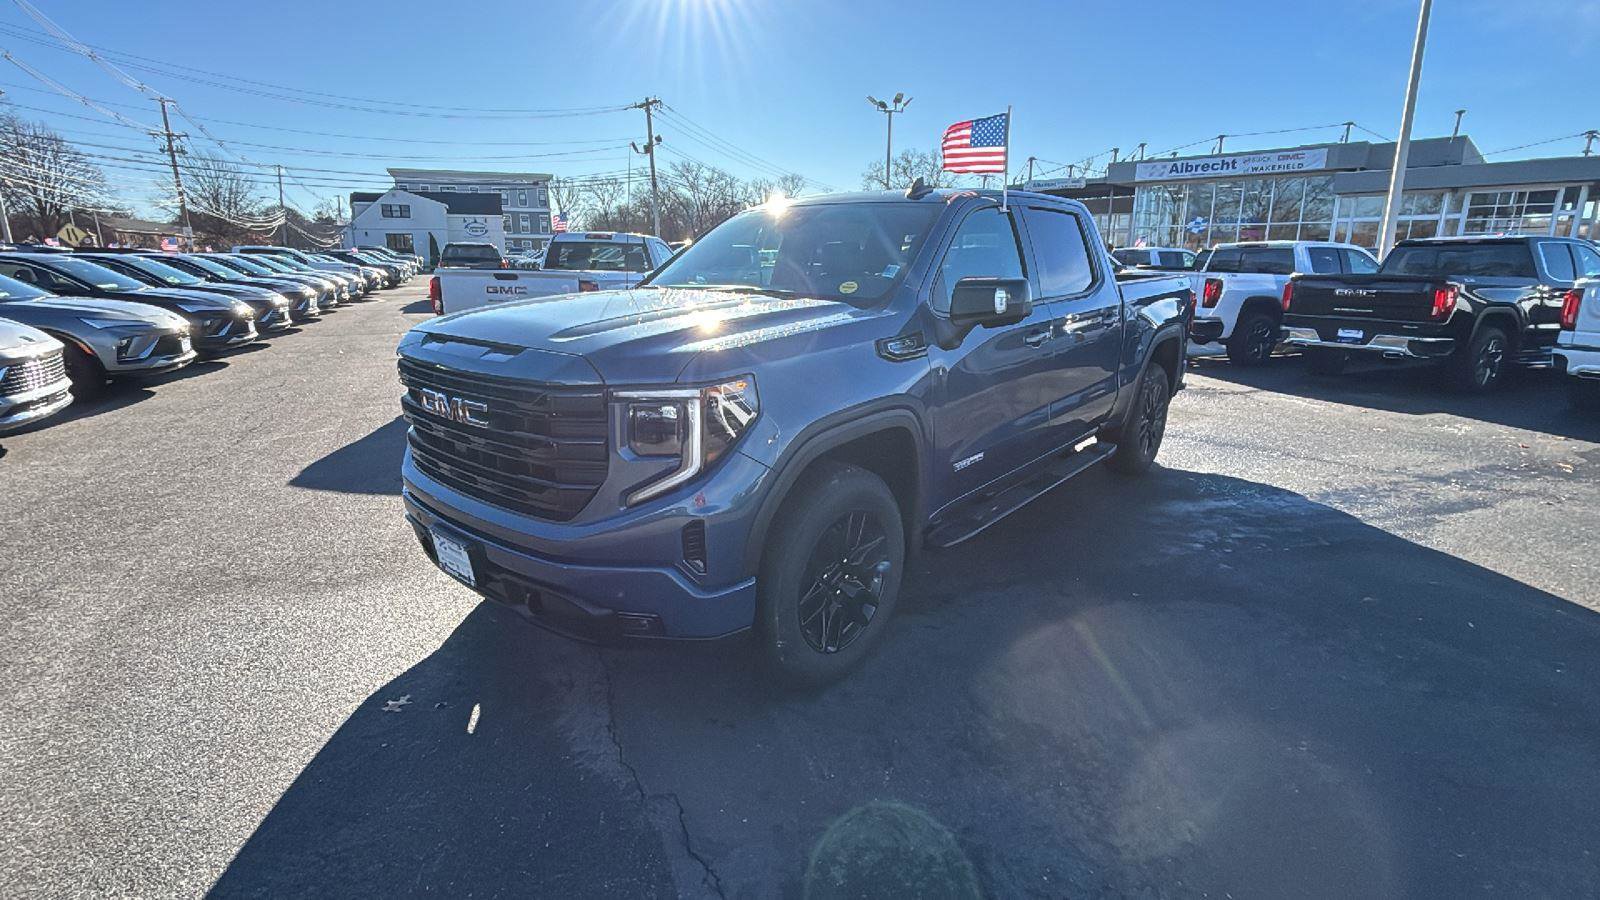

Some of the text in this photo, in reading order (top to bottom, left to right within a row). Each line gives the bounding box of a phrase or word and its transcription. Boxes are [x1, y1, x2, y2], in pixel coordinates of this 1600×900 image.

[1169, 159, 1237, 174] Albrecht
[1251, 163, 1304, 172] WAKEFIELD
[486, 286, 528, 295] GMC
[1334, 288, 1377, 298] GMC
[419, 388, 489, 428] GMC
